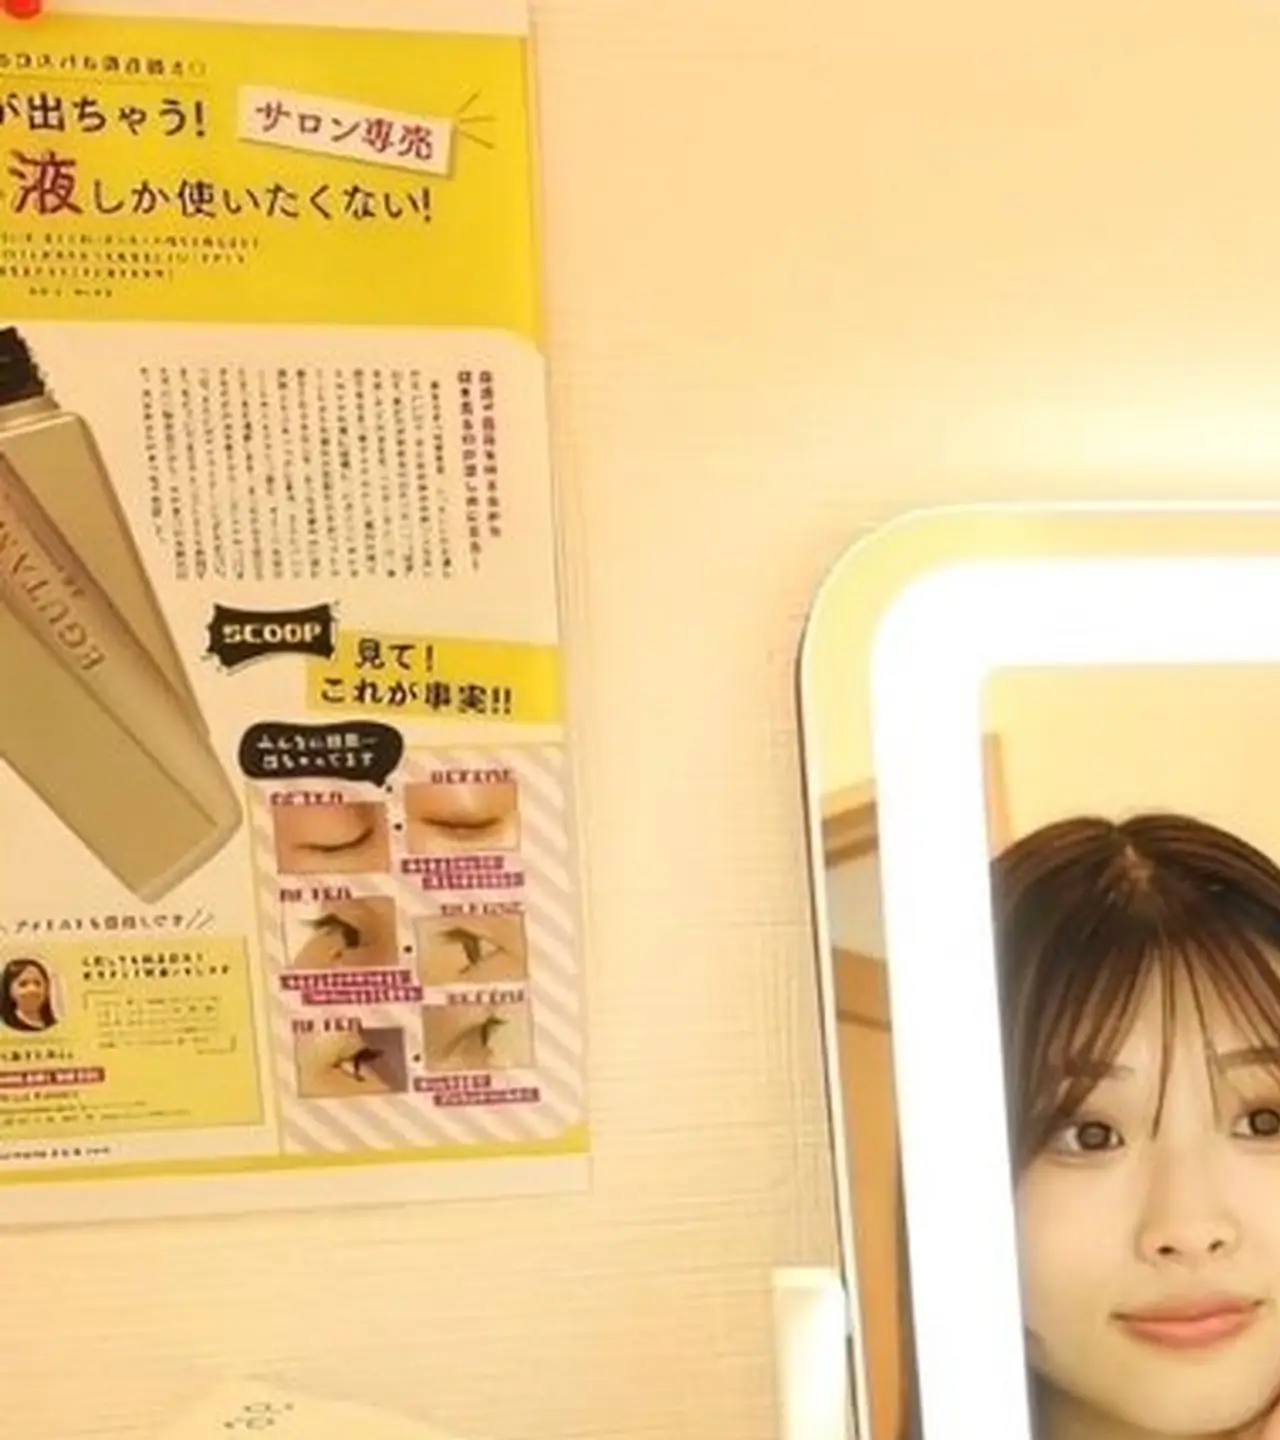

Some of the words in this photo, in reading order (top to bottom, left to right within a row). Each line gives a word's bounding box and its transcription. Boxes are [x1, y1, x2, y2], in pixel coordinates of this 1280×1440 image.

[255, 100, 433, 162] サロン専売
[222, 623, 323, 645] SCOOP
[355, 637, 435, 673] 見て!
[321, 677, 512, 716] これが事実!!
